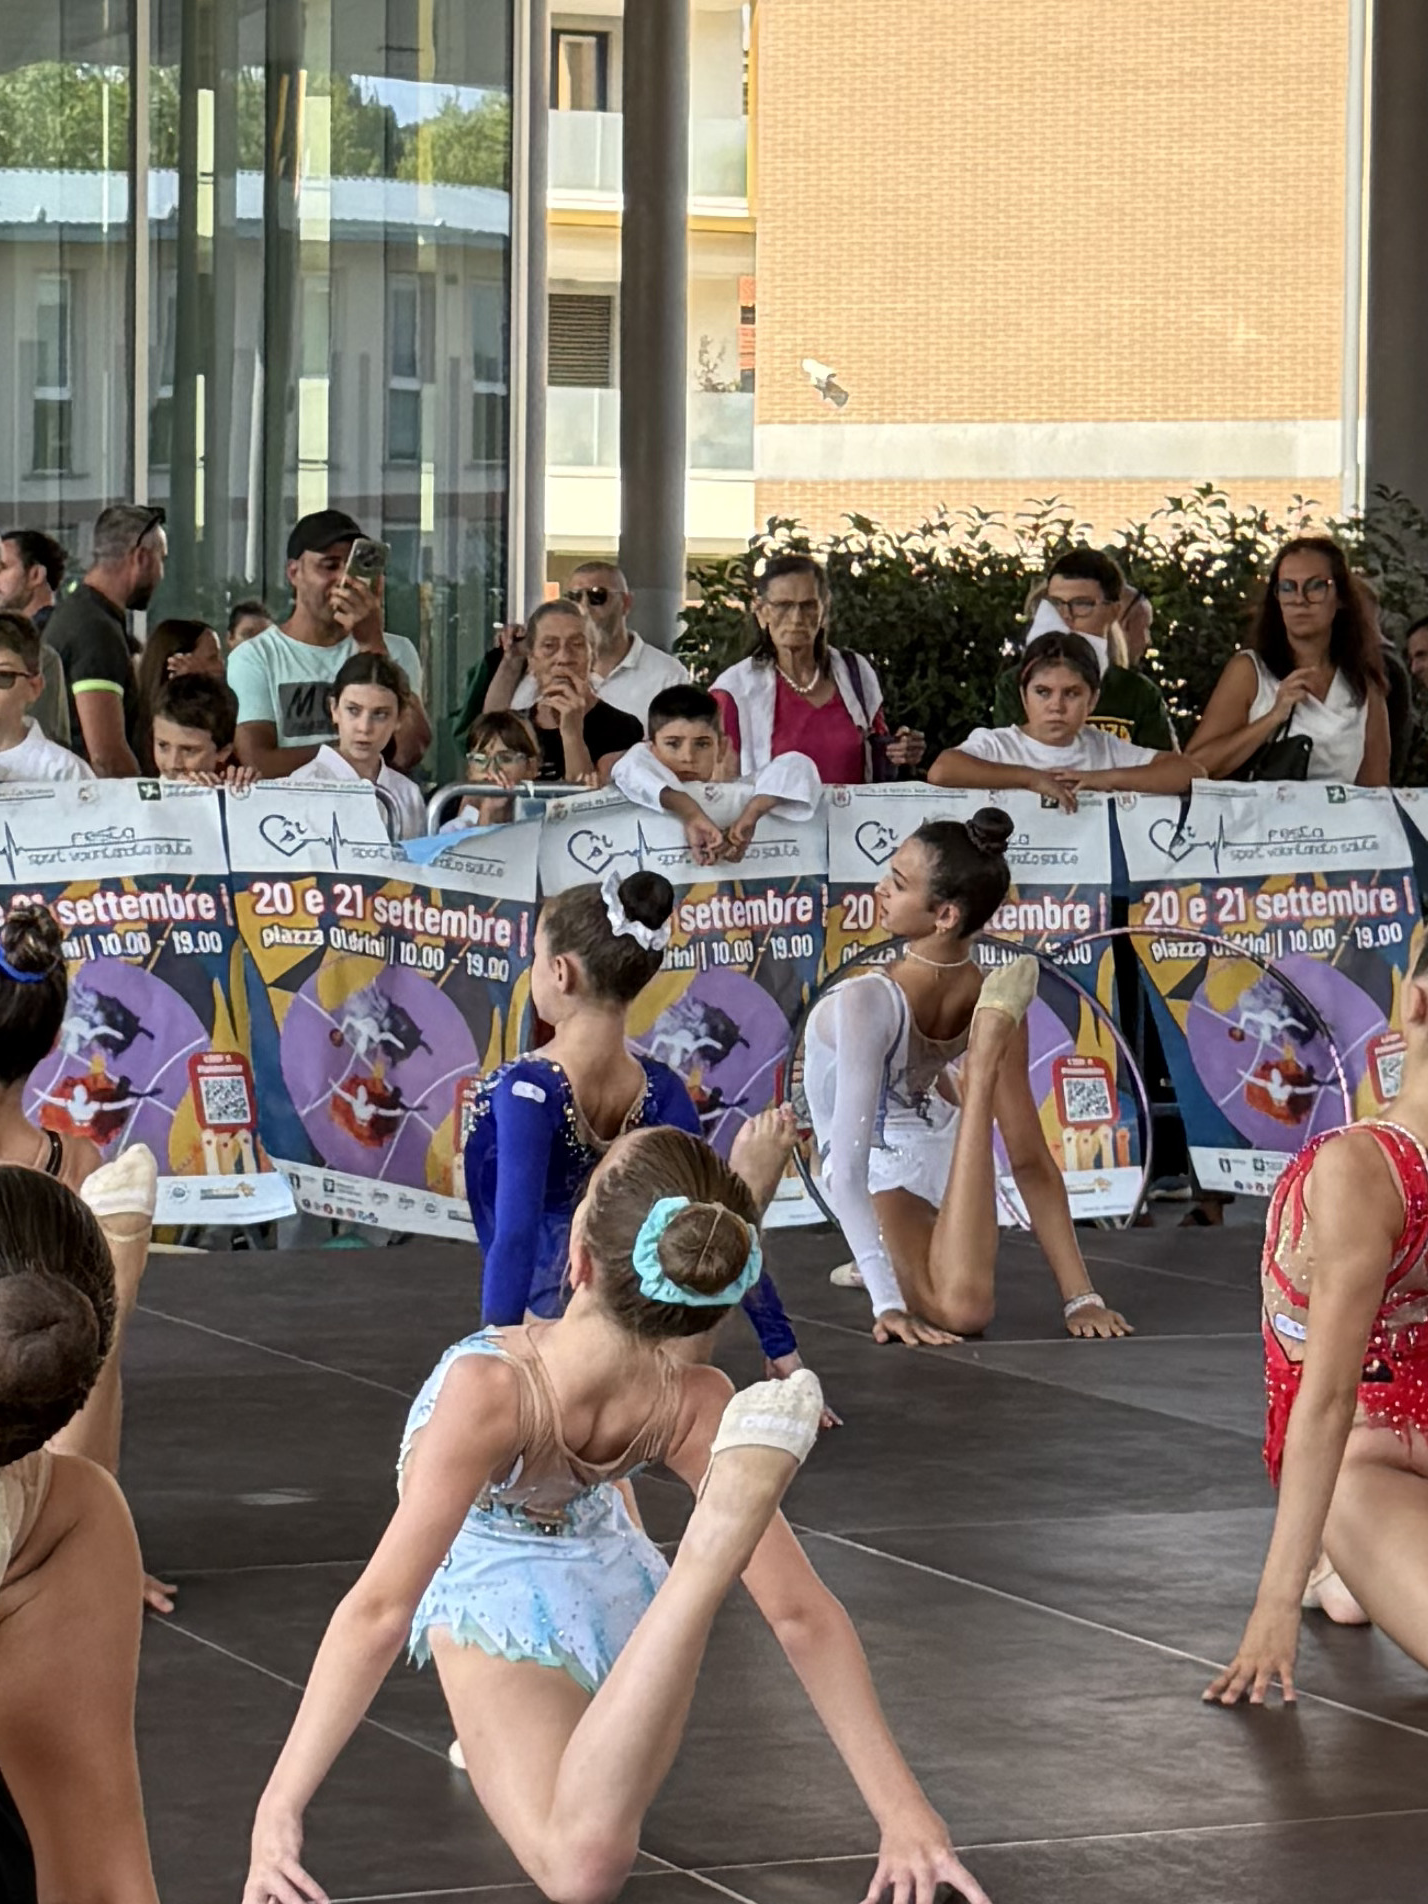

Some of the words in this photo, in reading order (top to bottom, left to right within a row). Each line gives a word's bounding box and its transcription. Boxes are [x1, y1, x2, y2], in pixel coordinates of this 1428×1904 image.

[58, 882, 217, 926] settembre
[252, 881, 294, 915] 20
[305, 890, 324, 915] e
[333, 884, 364, 919] 21
[373, 894, 511, 946] settembre
[680, 887, 814, 932] settembre
[842, 893, 873, 930] 20
[984, 895, 1091, 931] tembre
[1144, 891, 1179, 926] 20
[1189, 896, 1207, 923] e
[1217, 887, 1246, 922] 21
[1256, 881, 1398, 920] settembre
[98, 932, 151, 957] 10.00
[172, 930, 222, 955] 19.00
[262, 927, 324, 949] piazza
[330, 926, 386, 957] Oldrini
[400, 942, 445, 970] 10.00
[466, 952, 510, 982] 19.00
[712, 939, 755, 964] 10.00
[770, 934, 813, 960] 19.00
[1152, 938, 1206, 962] piazza
[1290, 928, 1336, 953] 10.00
[1355, 922, 1403, 949] 19.00
